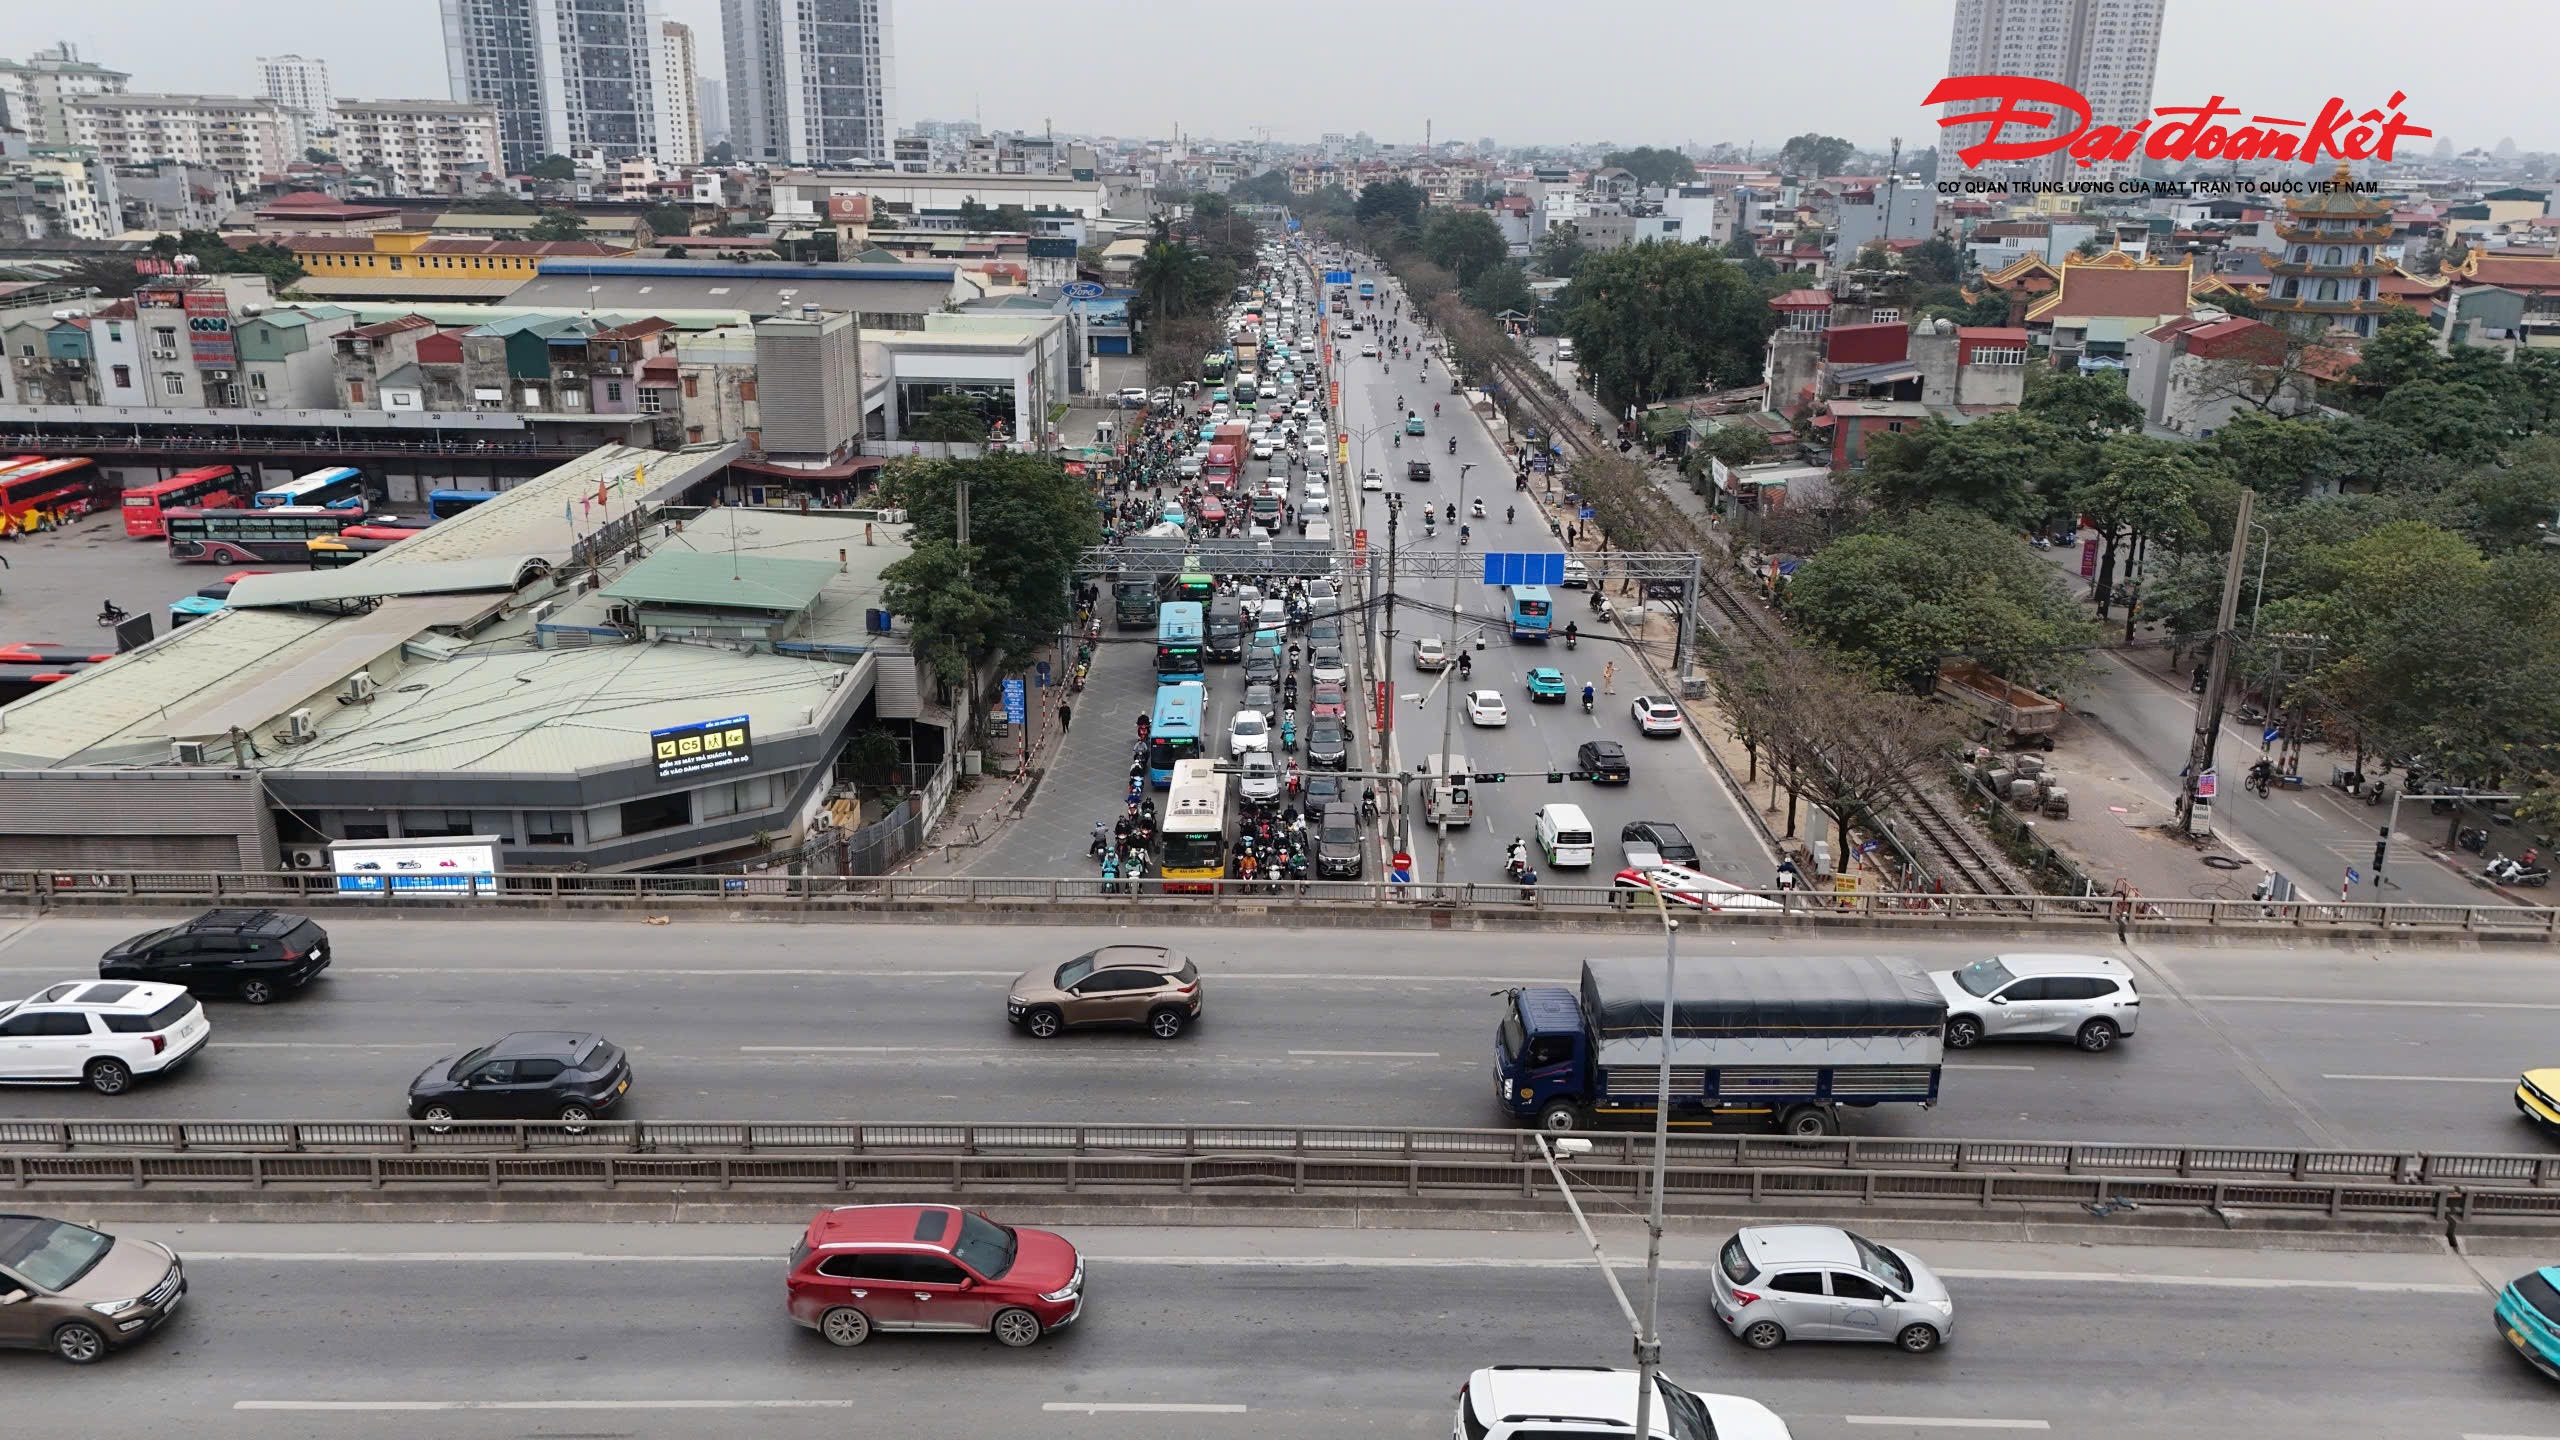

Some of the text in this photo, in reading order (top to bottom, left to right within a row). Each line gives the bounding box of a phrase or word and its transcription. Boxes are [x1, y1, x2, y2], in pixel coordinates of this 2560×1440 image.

[1069, 282, 1096, 296] Ford
[682, 740, 698, 750] C5
[670, 767, 683, 775] VÀO
[683, 765, 700, 773] DÀNH
[740, 754, 749, 762] BỘ
